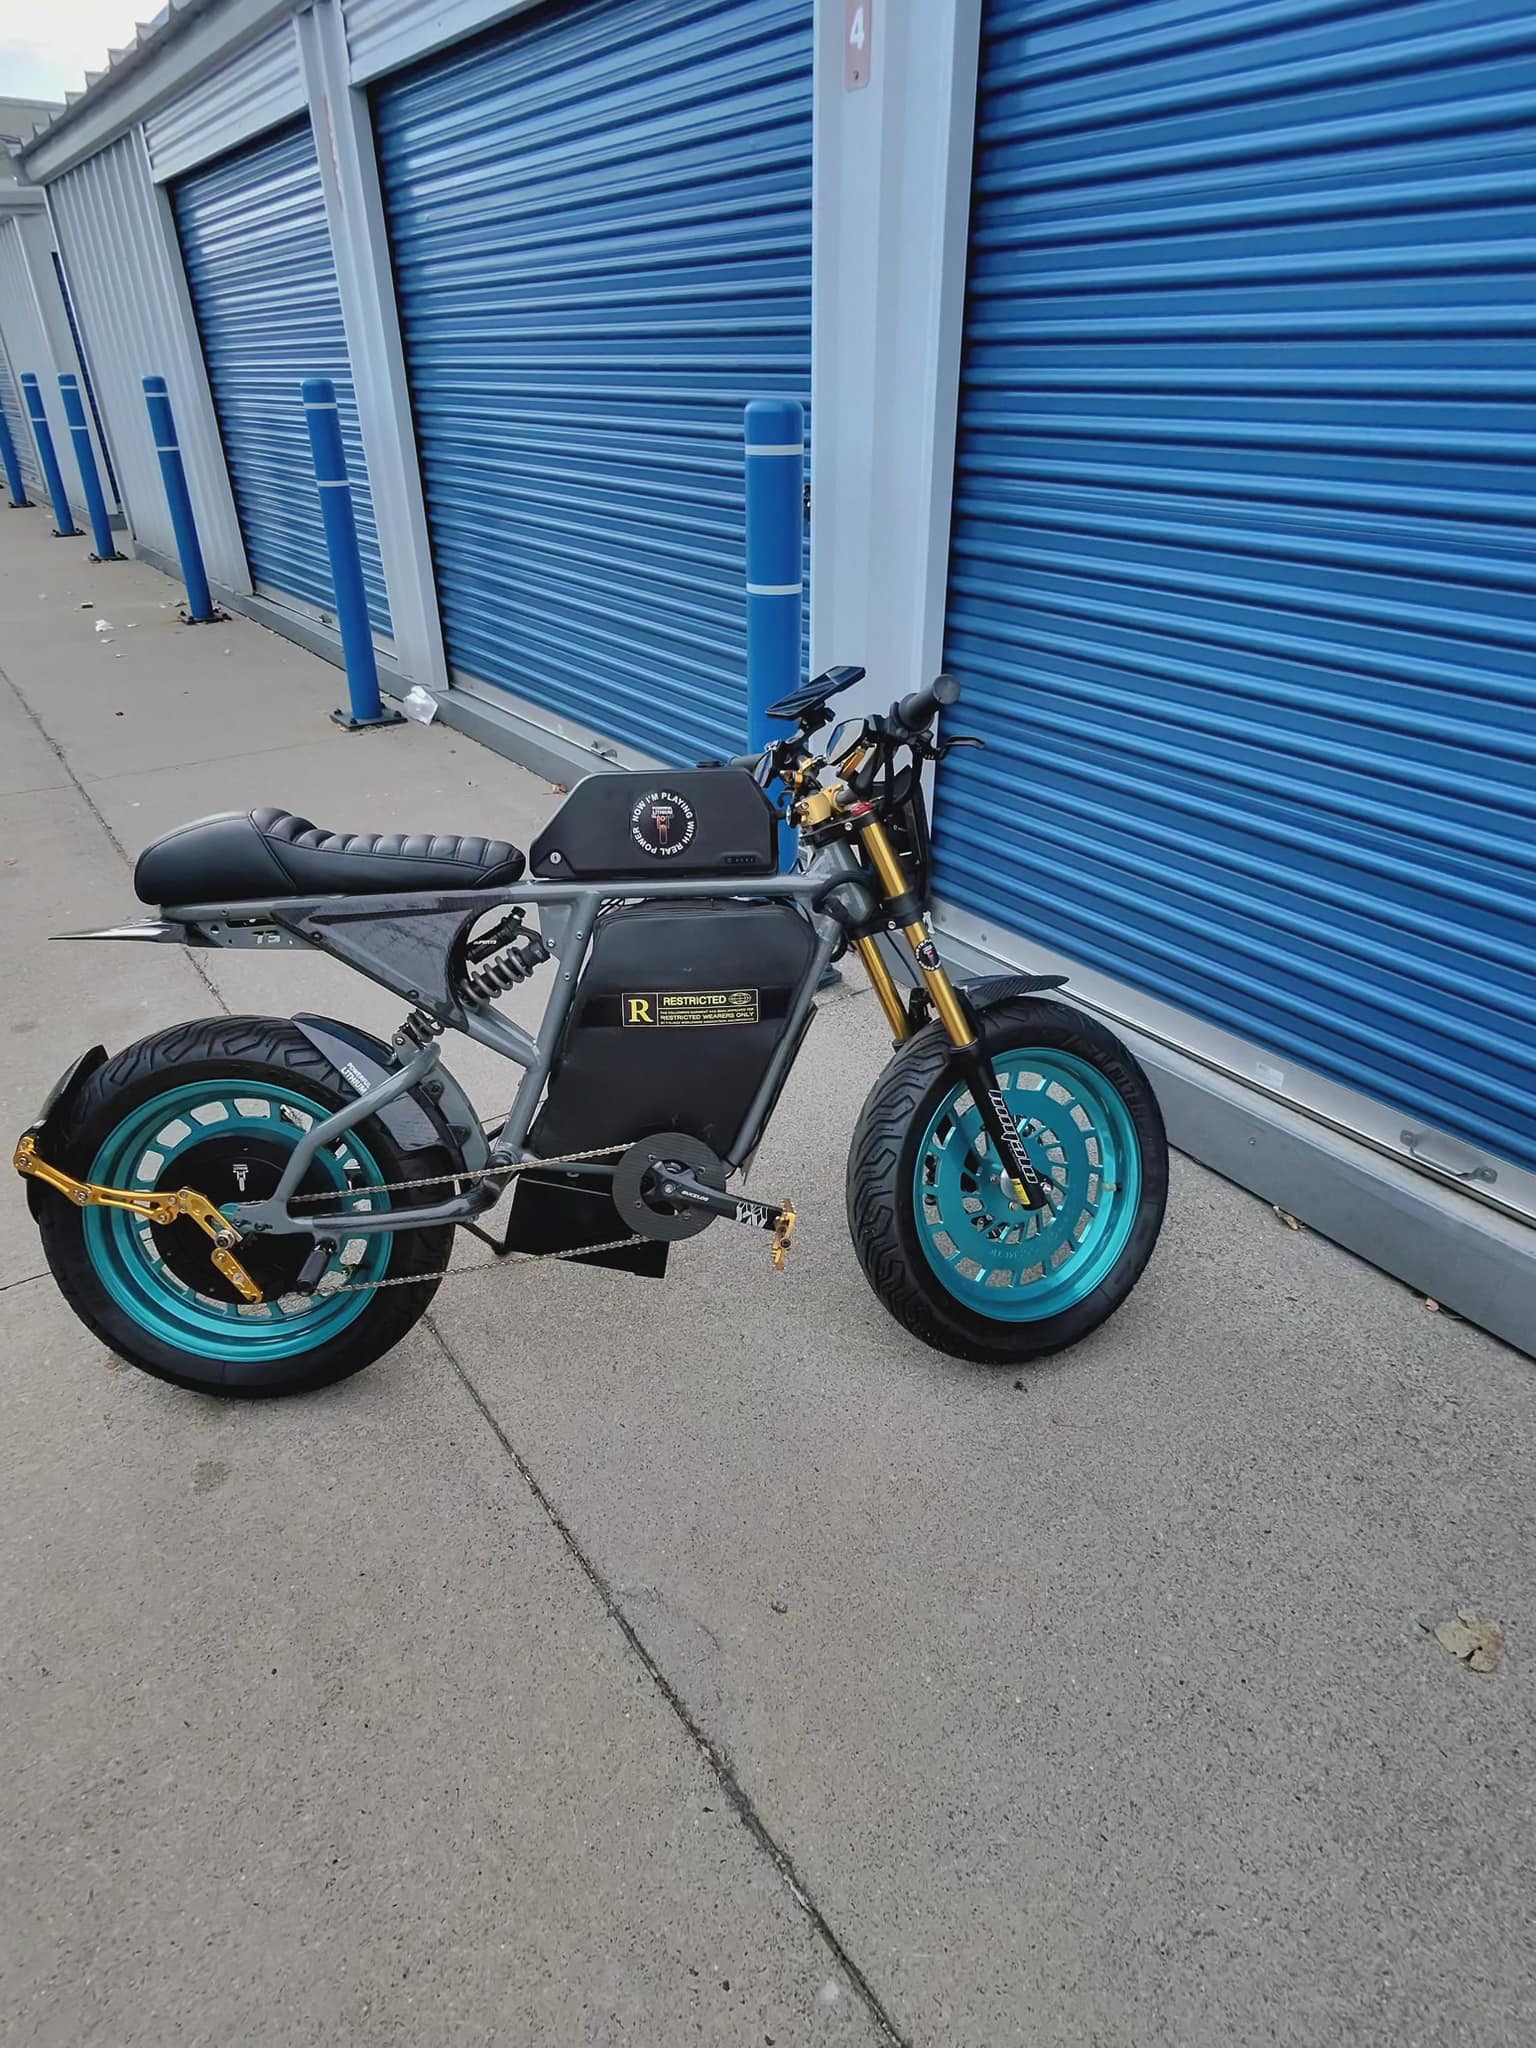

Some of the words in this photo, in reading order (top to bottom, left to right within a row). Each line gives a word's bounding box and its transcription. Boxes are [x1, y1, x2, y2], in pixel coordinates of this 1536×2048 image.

[849, 7, 865, 49] 4
[645, 792, 659, 804] I'M
[661, 792, 693, 819] PLAYING
[632, 800, 646, 822] NOW
[632, 826, 658, 854] POWER
[682, 821, 695, 844] WITH
[660, 842, 684, 856] REAL
[628, 999, 654, 1022] R
[663, 995, 727, 1006] RESTRICTED
